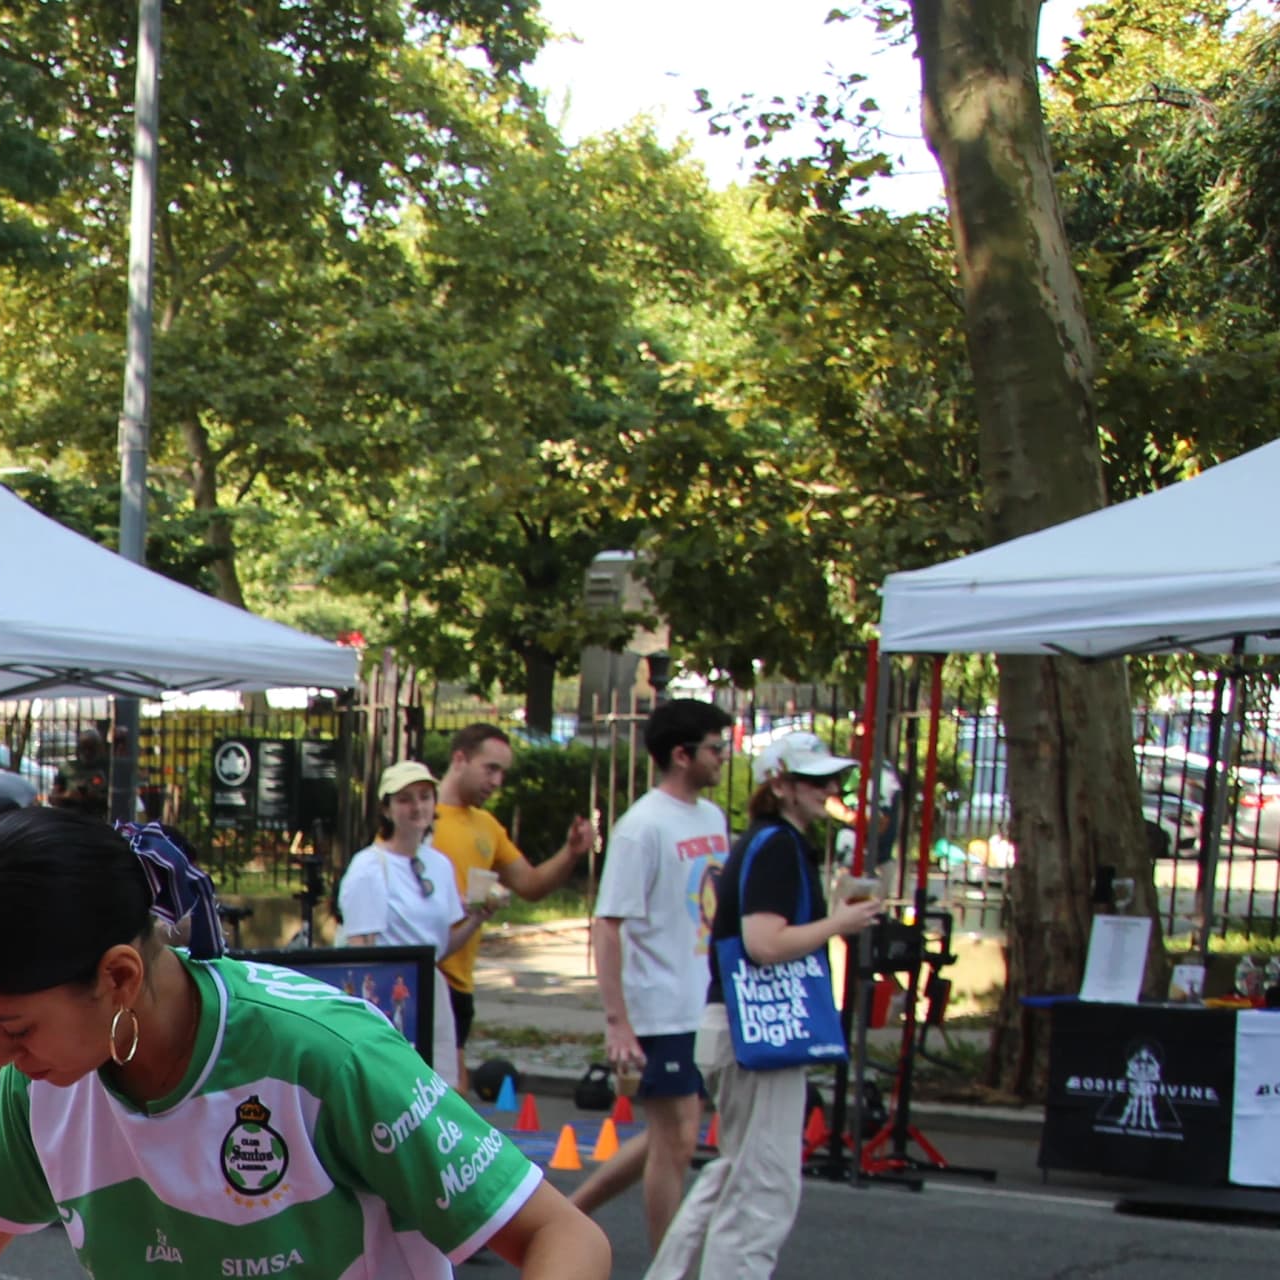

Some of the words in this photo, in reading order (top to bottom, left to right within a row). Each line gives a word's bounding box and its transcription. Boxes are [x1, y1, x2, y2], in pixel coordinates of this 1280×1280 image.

[734, 976, 809, 1003] Matt&
[738, 998, 810, 1023] Inez&
[741, 1018, 811, 1048] Digit.
[436, 1115, 464, 1155] de
[435, 1127, 504, 1211] México
[221, 1248, 305, 1278] SIMSA
